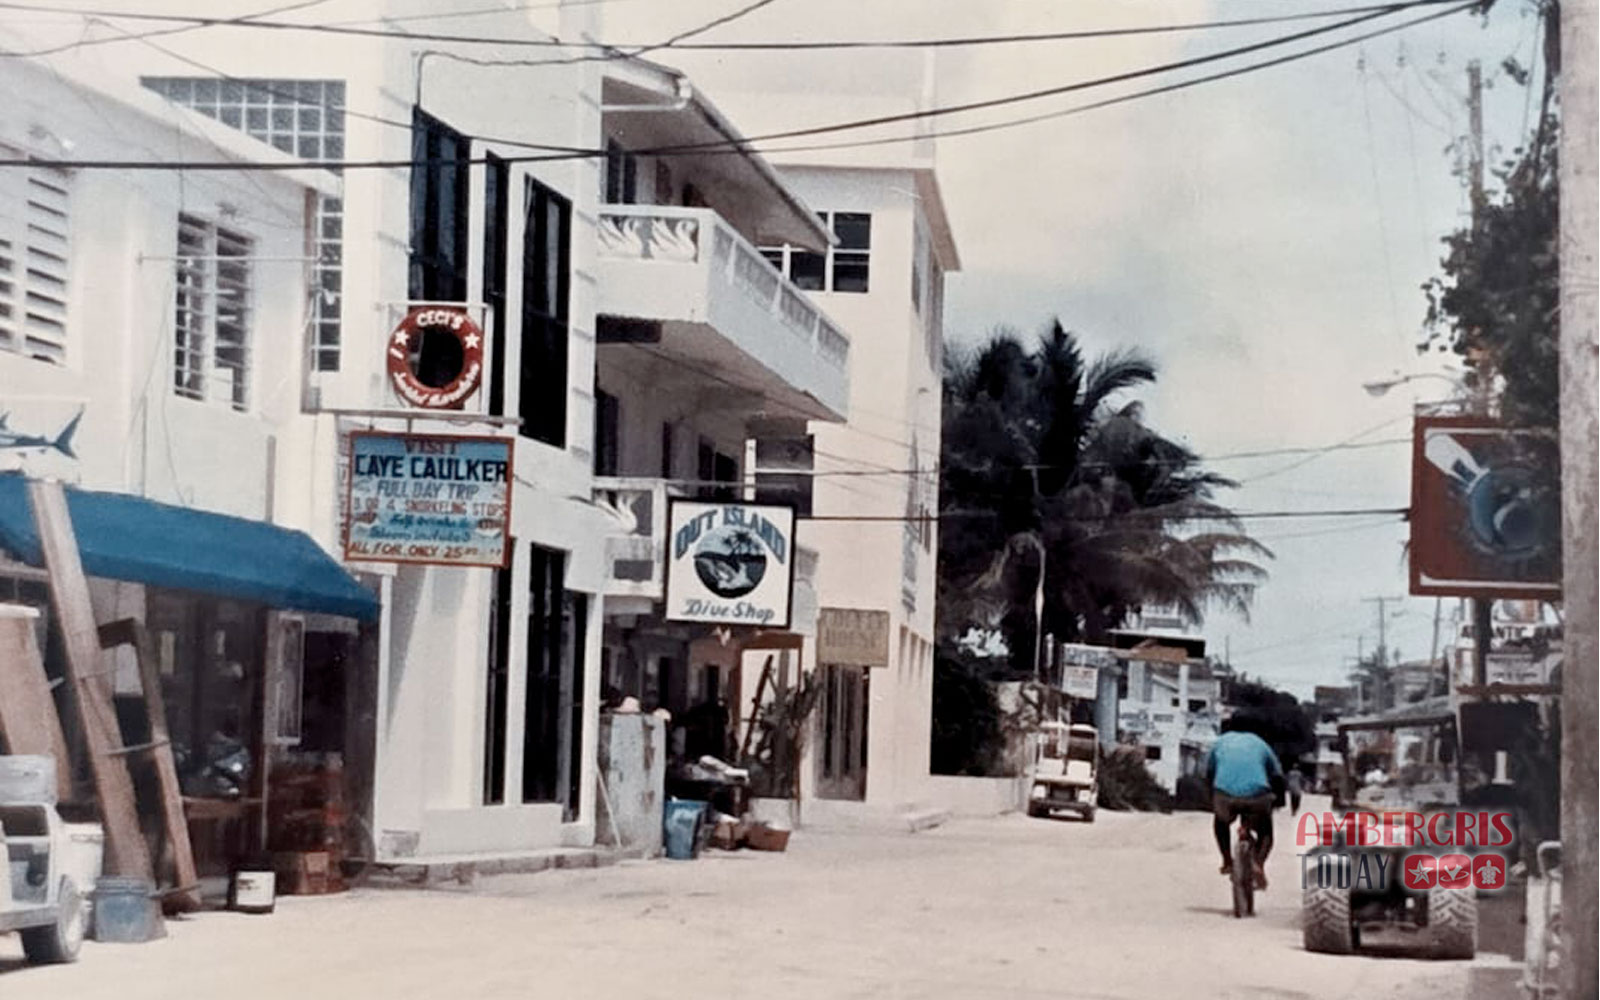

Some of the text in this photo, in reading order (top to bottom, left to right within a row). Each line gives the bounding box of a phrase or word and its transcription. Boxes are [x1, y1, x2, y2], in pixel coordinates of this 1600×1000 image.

[416, 310, 464, 329] CECI'S
[405, 439, 458, 455] VISIT
[355, 455, 508, 482] CAYE CAULKER
[377, 480, 479, 500] FULL DAY TRIP
[676, 507, 786, 565] OUT ISLAND
[350, 541, 369, 553] ALL
[681, 599, 775, 624] Dive Shop
